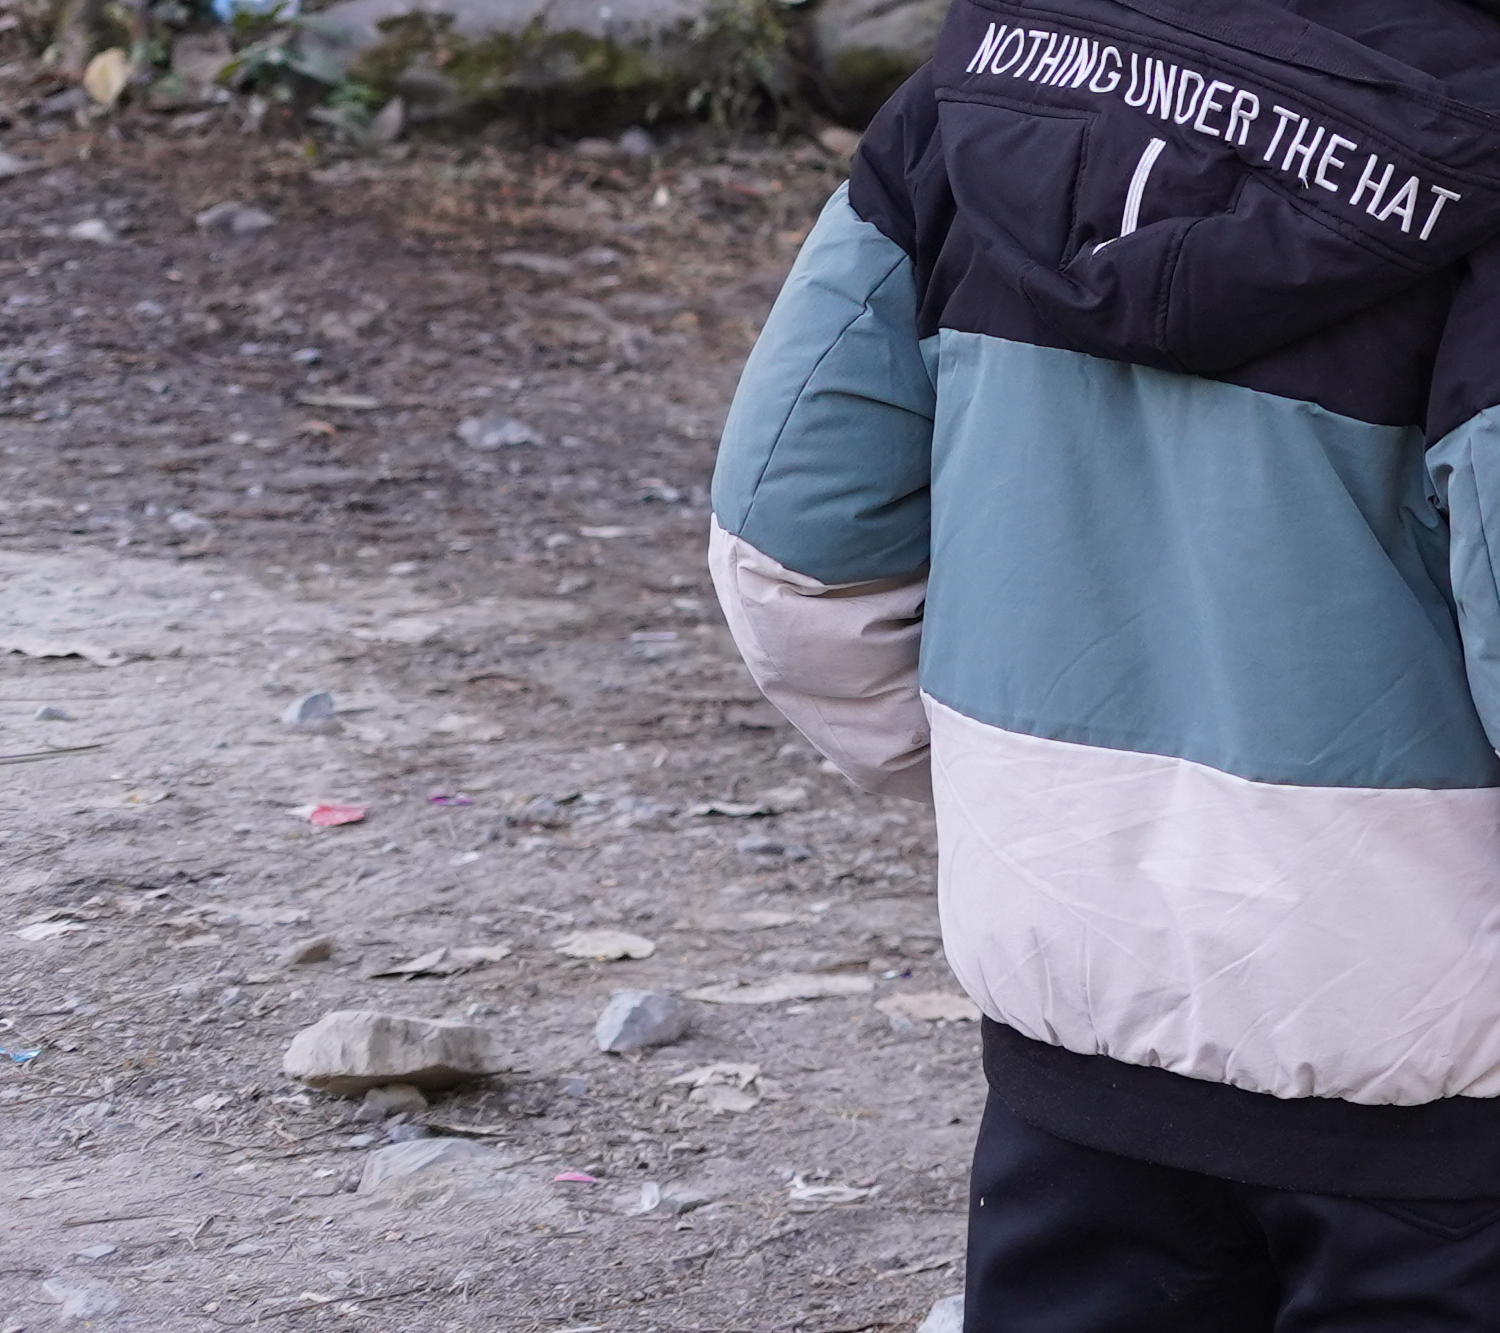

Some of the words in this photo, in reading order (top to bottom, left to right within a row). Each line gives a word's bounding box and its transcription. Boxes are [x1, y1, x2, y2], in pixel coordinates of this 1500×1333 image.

[966, 22, 1123, 94] NOTHING
[1125, 52, 1260, 146] UNDER
[1262, 105, 1358, 193] THE
[1349, 152, 1462, 242] HAT
